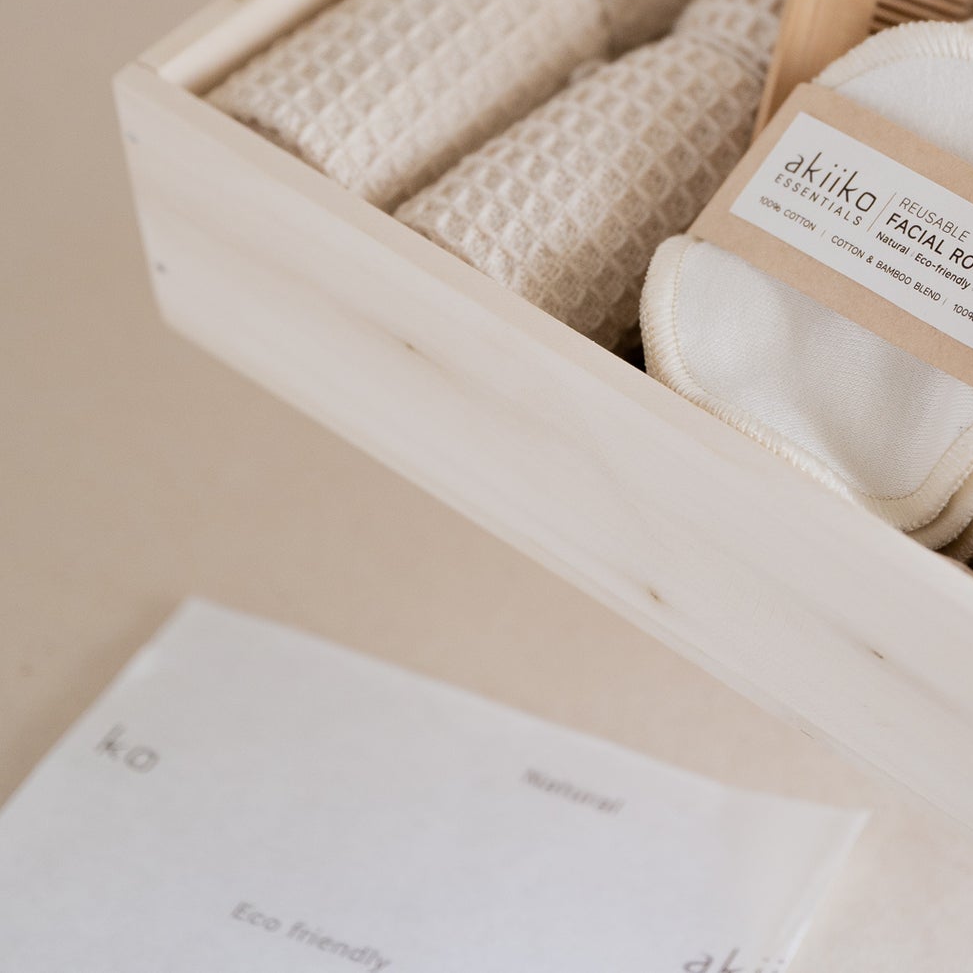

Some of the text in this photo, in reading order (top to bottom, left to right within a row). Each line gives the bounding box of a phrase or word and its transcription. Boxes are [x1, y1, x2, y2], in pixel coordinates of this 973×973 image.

[774, 173, 863, 226] ESSENTIALS
[784, 152, 877, 212] akiiko
[886, 212, 945, 255] FACIAL
[898, 197, 970, 243] REUSABLE
[759, 195, 782, 213] 100%
[783, 209, 817, 231] COTTON
[831, 235, 866, 259] COTTON
[865, 255, 875, 264] &
[875, 260, 912, 286] BAMBOO
[913, 281, 942, 302] BLEND
[875, 231, 911, 255] Natural
[914, 252, 972, 290] Eco-friendly
[231, 900, 282, 933] Eco
